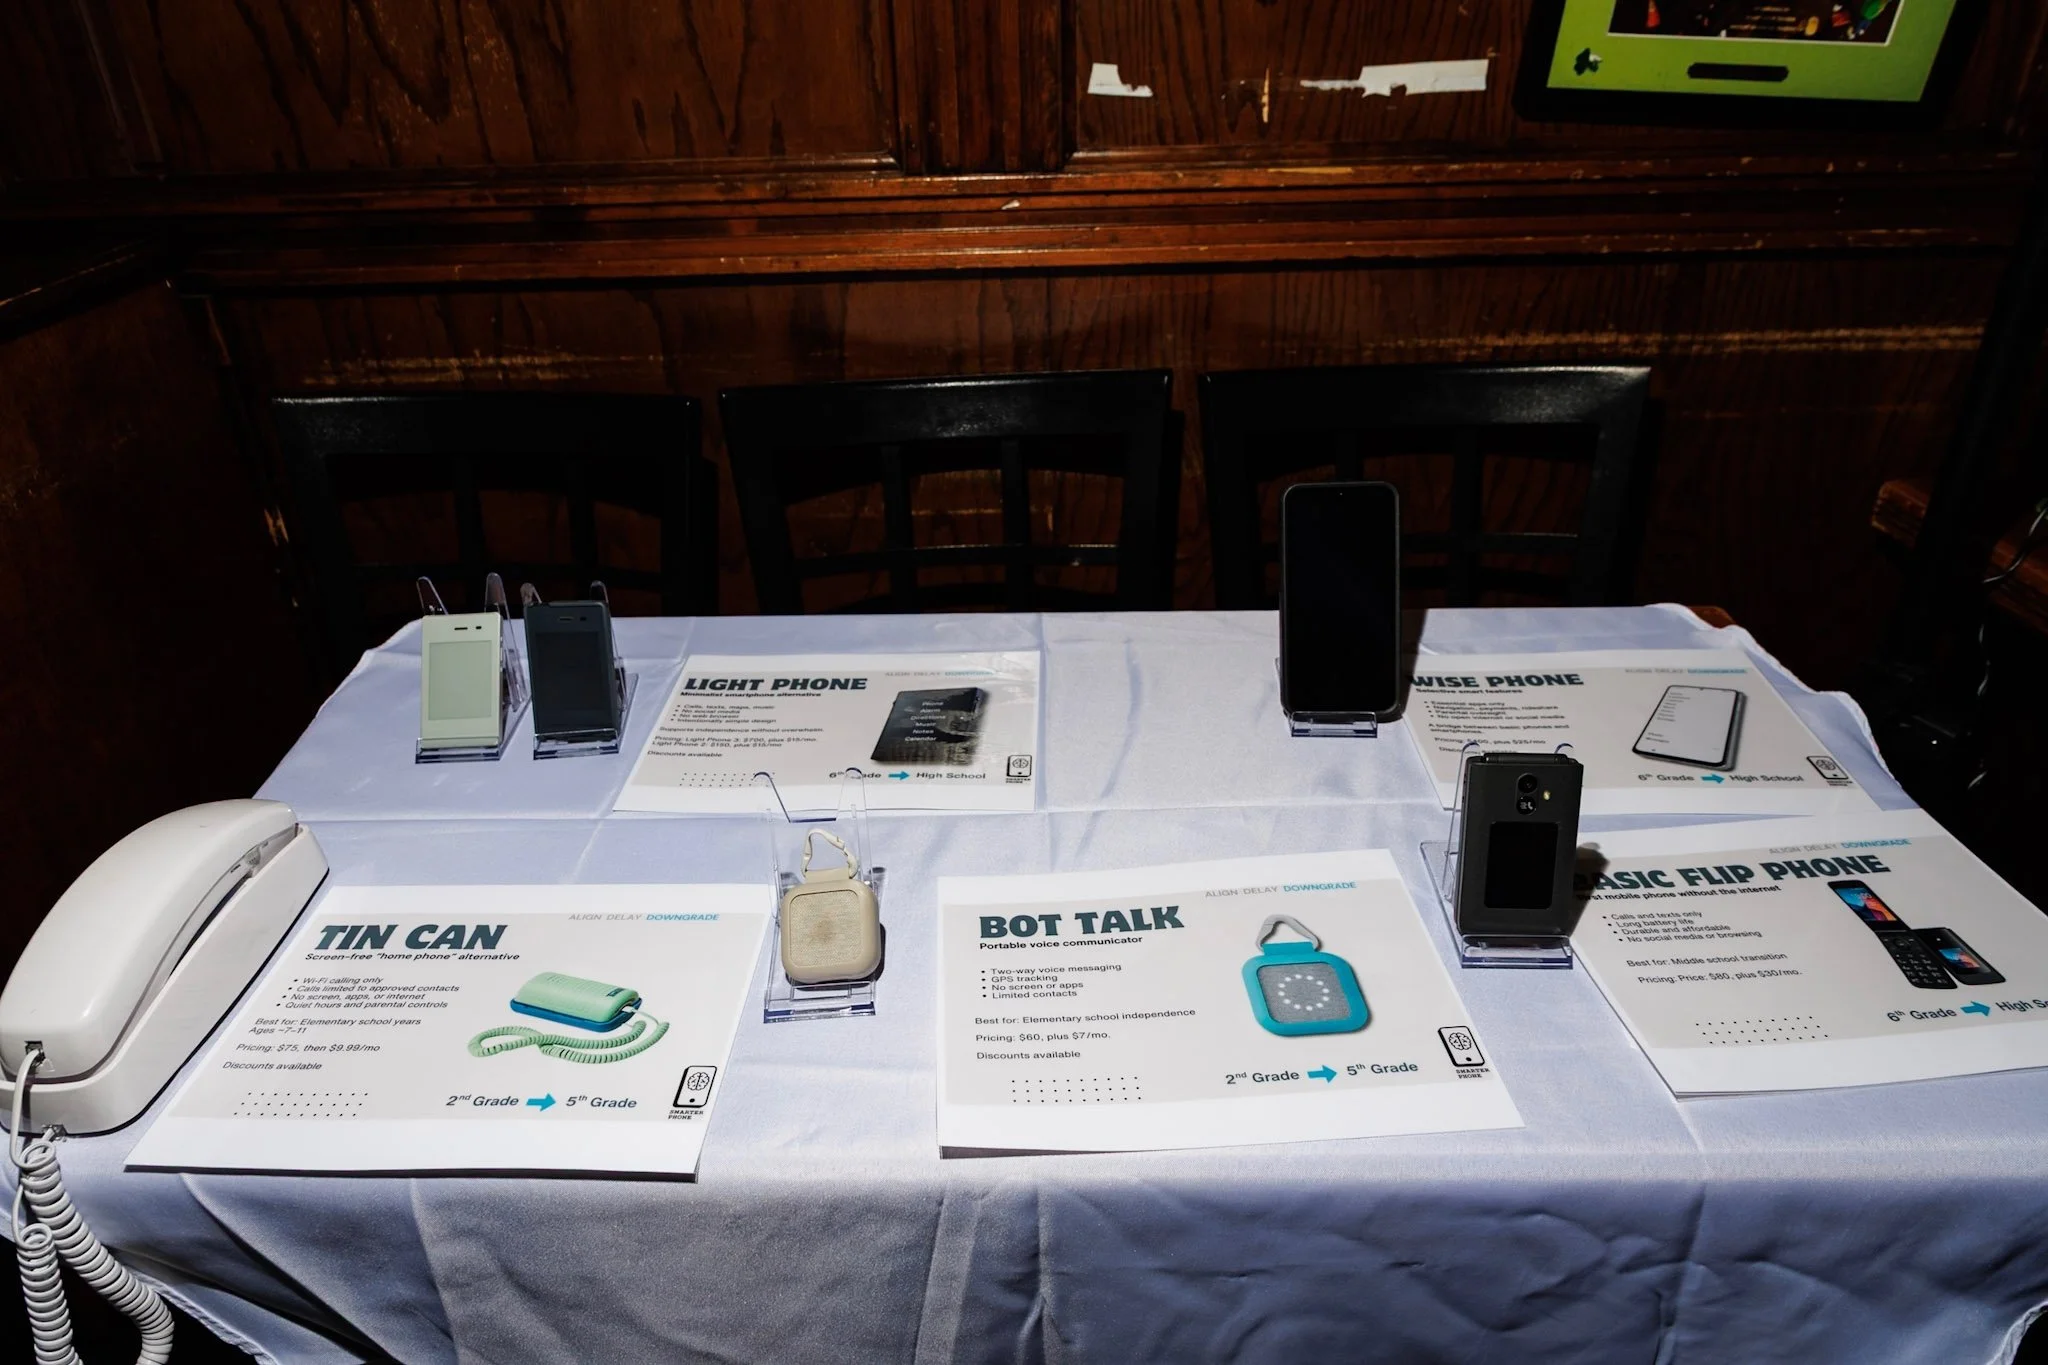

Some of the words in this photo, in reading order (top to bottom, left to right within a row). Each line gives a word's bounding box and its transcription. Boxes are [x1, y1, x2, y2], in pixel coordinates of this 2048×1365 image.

[683, 677, 765, 691] LIGHT
[770, 677, 868, 690] PHONE
[1406, 675, 1480, 688] WISE
[1485, 673, 1584, 687] PHONE
[1728, 774, 1759, 782] High
[1840, 838, 1912, 849] DOWNGRADE
[1675, 864, 1755, 886] FLIP
[1758, 854, 1891, 881] PHONE
[1243, 886, 1277, 894] DELAY
[1282, 881, 1356, 892] DOWNGRADE
[1642, 892, 1676, 900] phone
[1737, 885, 1782, 893] internet
[645, 913, 719, 921] DOWNGRADE
[1681, 910, 1702, 918] only
[978, 913, 1062, 938] BOT
[1074, 905, 1185, 935] TALK
[1620, 927, 1660, 935] Durable
[1681, 924, 1731, 932] affordable
[314, 924, 399, 950] TIN
[404, 923, 508, 950] CAN
[1643, 934, 1673, 942] social
[1715, 930, 1763, 938] browsing
[979, 941, 1027, 949] Portable
[1029, 940, 1060, 948] voice
[1062, 936, 1142, 947] communicator
[457, 952, 520, 960] alternative
[1625, 959, 1651, 967] Best
[1669, 957, 1705, 965] Middle
[1705, 955, 1740, 963] school
[1739, 953, 1788, 961] transition
[1067, 964, 1122, 972] messaging
[362, 976, 384, 984] only
[990, 975, 1014, 983] GPS
[1637, 976, 1677, 984] Pricing:
[1734, 972, 1757, 980] plus
[1756, 969, 1803, 978] $30/mo.
[321, 984, 356, 992] limited
[344, 993, 370, 1001] apps,
[992, 991, 1030, 999] Limited
[1032, 990, 1077, 998] contacts
[363, 1001, 407, 1009] parental
[1022, 1015, 1082, 1023] Elementary
[1084, 1013, 1119, 1021] school
[1121, 1009, 1196, 1019] independence
[1886, 1010, 1906, 1022] 6th
[1909, 1007, 1957, 1020] Grade
[1995, 1000, 2034, 1012] High
[254, 1017, 279, 1025] Best
[299, 1018, 357, 1026] Elementary
[248, 1026, 275, 1035] Ages
[975, 1034, 1015, 1043] Pricing:
[1018, 1033, 1044, 1042] $60,
[1046, 1033, 1069, 1042] plus
[1071, 1031, 1110, 1040] $7/mo.
[235, 1043, 275, 1053] Pricing:
[303, 1044, 327, 1052] then
[328, 1043, 381, 1052] $9.99/mo
[1033, 1050, 1081, 1059] available
[222, 1061, 275, 1070] Discounts
[275, 1062, 323, 1070] available
[1225, 1071, 1247, 1084] 2nd
[1251, 1070, 1300, 1083] Grade
[1346, 1063, 1366, 1076] 5th
[1370, 1062, 1418, 1074] Grade
[445, 1094, 472, 1106] 2nd
[472, 1095, 519, 1106] Grade
[565, 1095, 588, 1106] 5th
[589, 1096, 637, 1108] Grade
